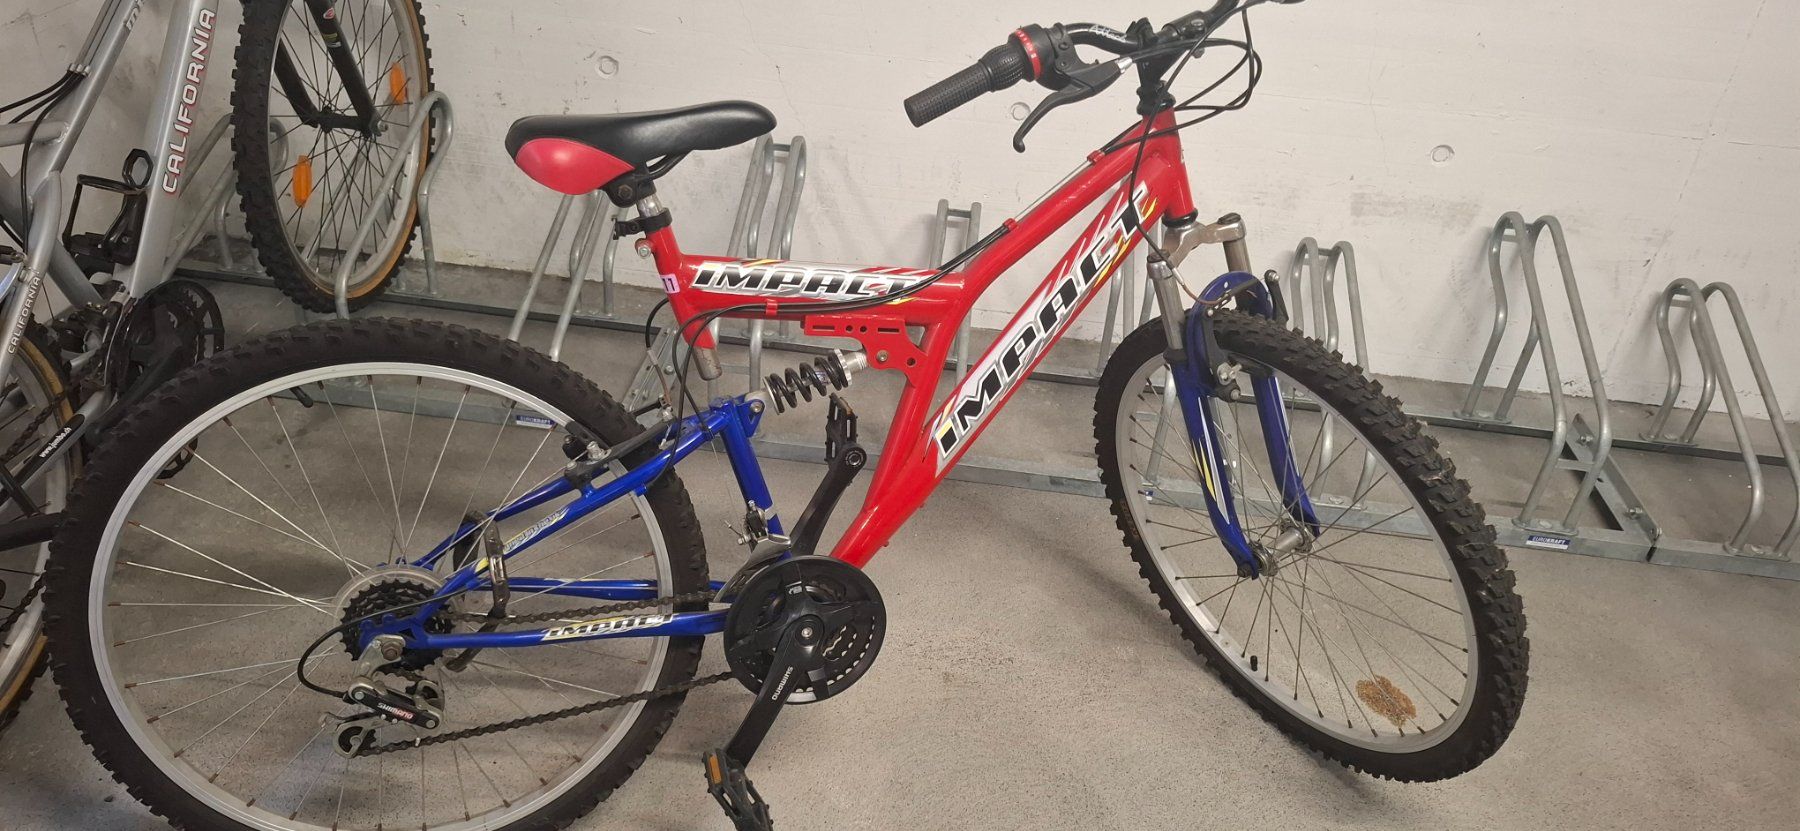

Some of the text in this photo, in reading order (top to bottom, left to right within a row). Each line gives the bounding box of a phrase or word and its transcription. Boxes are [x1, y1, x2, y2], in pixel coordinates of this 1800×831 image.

[162, 8, 217, 193] CALIFORNIA
[692, 261, 928, 297] IMPACT
[8, 276, 41, 354] CALIFORNIA
[935, 181, 1150, 458] IMPACT
[39, 427, 72, 458] www.jumbo.ch
[545, 613, 674, 639] IMPACT
[771, 665, 794, 701] SHIMANO
[377, 702, 415, 720] SHIMANO
